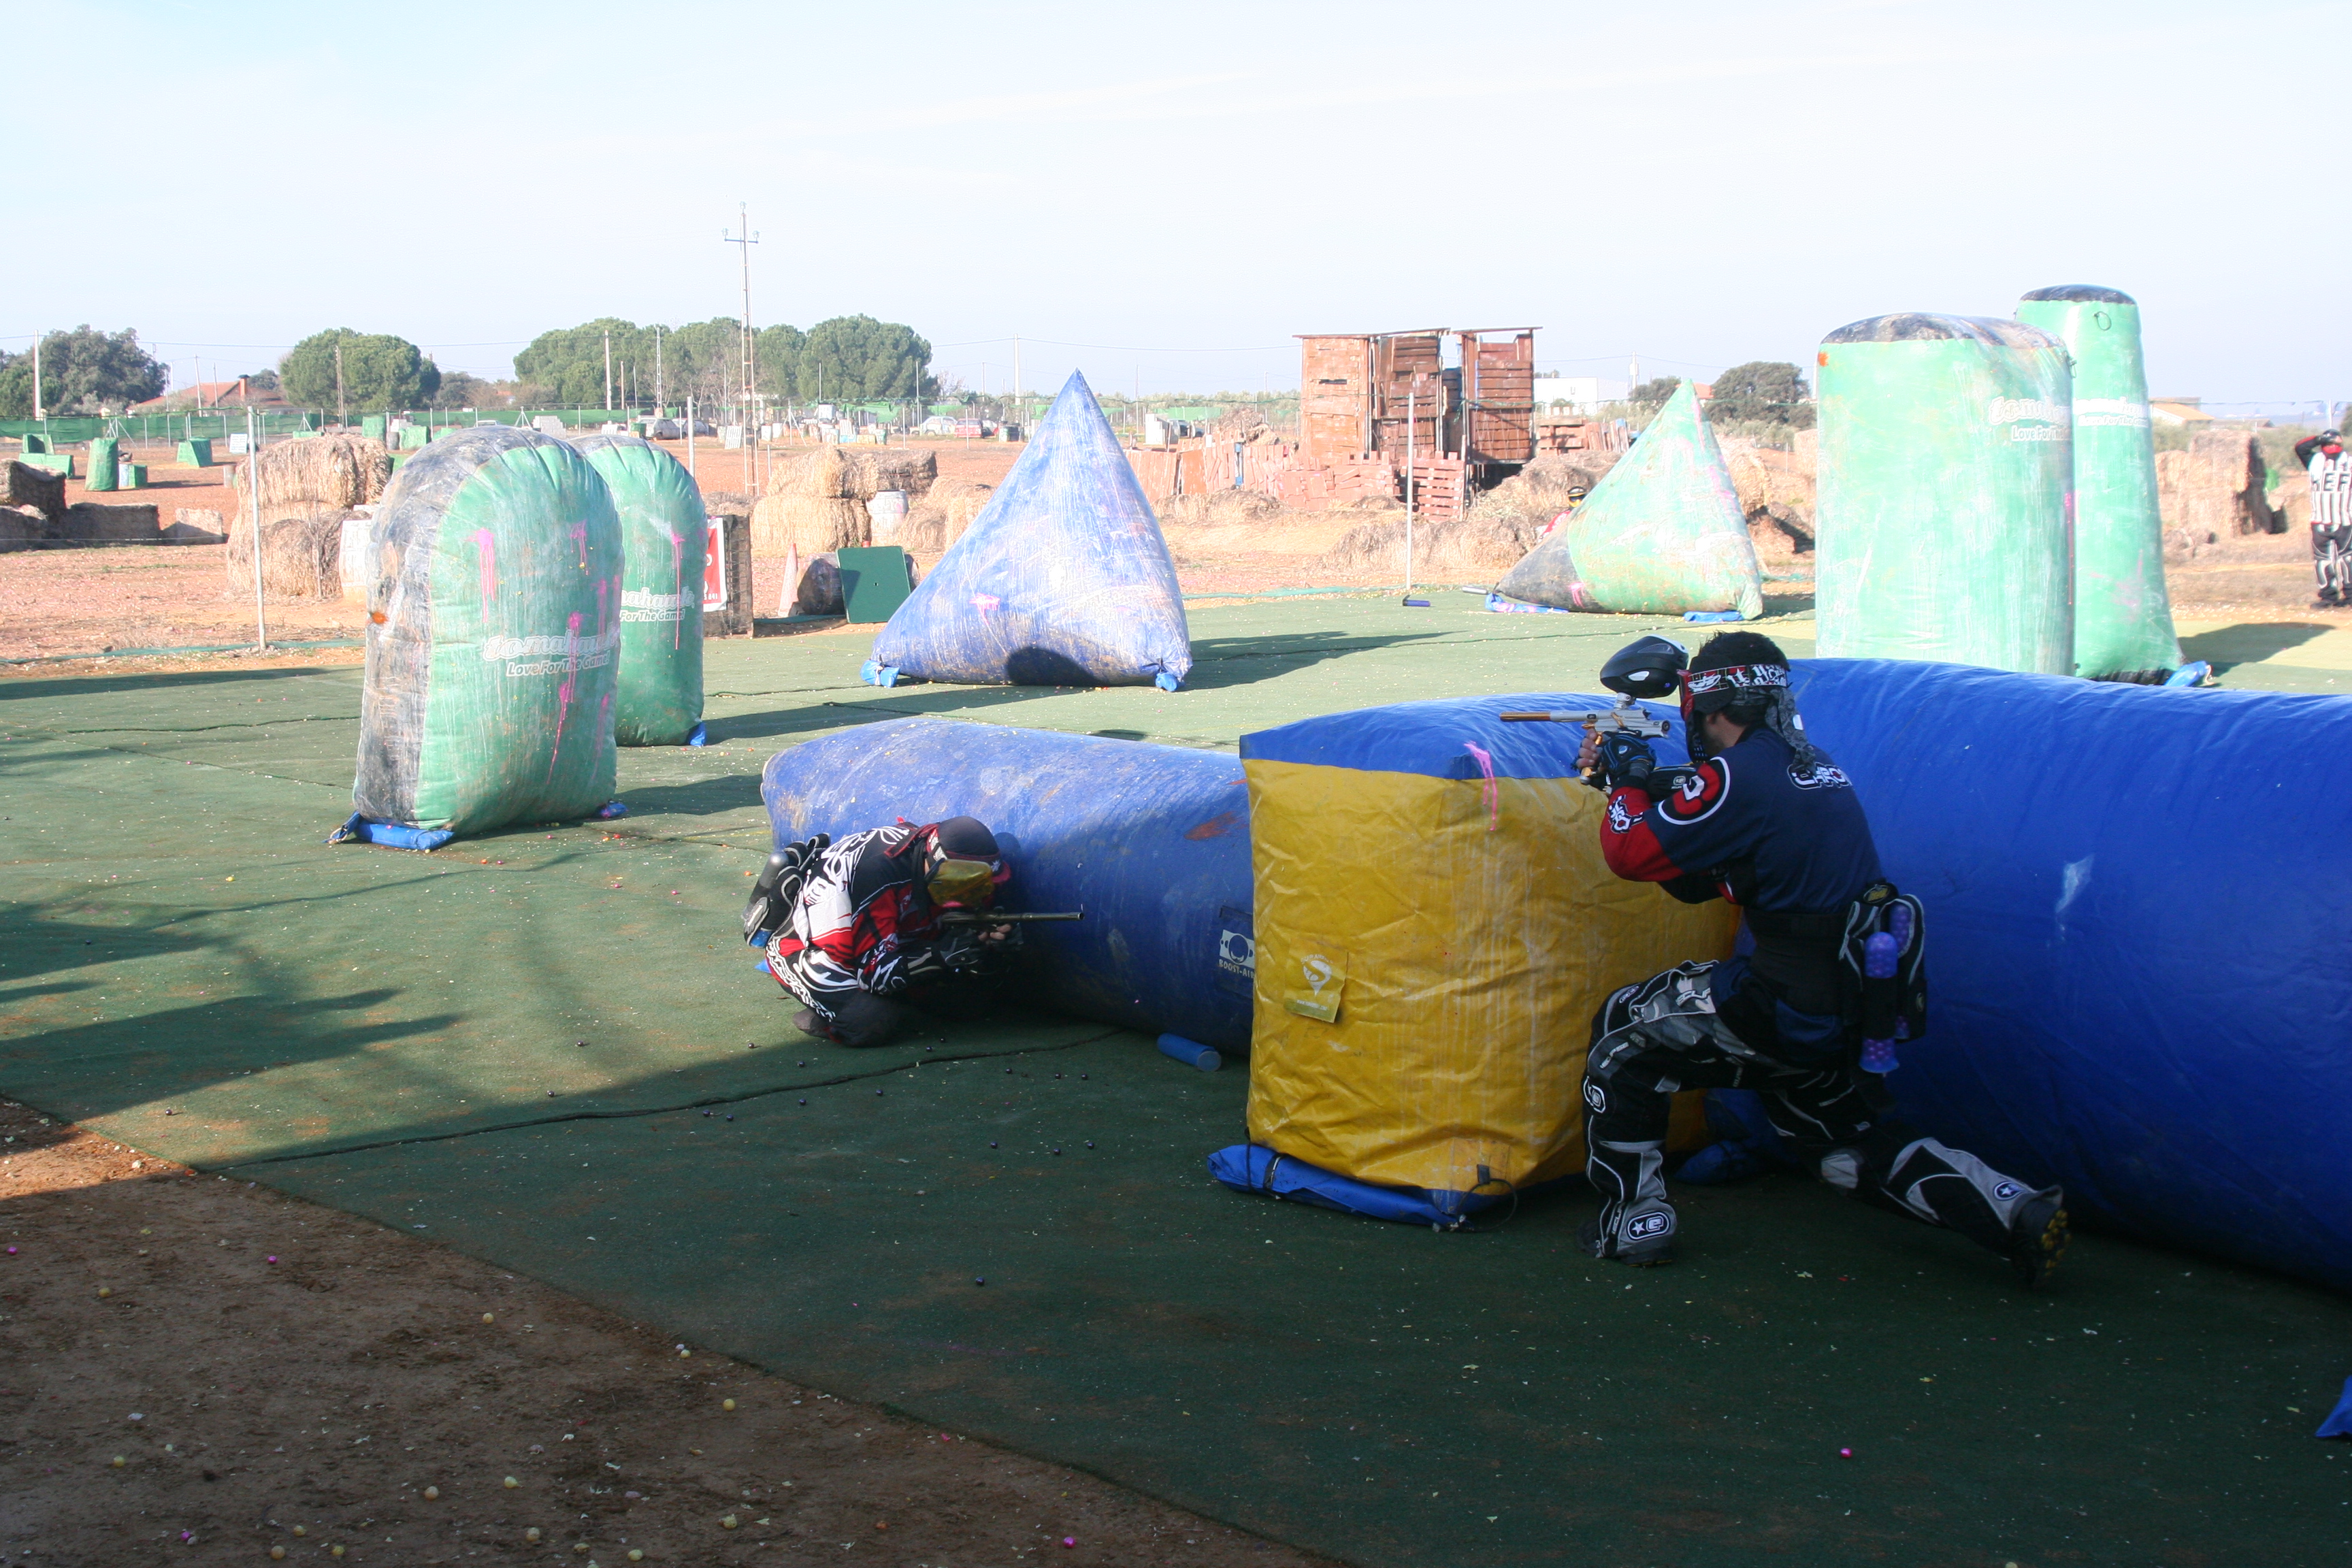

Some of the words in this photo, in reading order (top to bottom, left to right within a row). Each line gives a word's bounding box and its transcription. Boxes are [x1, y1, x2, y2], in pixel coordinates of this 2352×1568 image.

[2012, 425, 2036, 442] Love
[619, 610, 638, 622] For
[638, 610, 657, 622] The
[506, 662, 542, 677] Love
[540, 659, 564, 674] For
